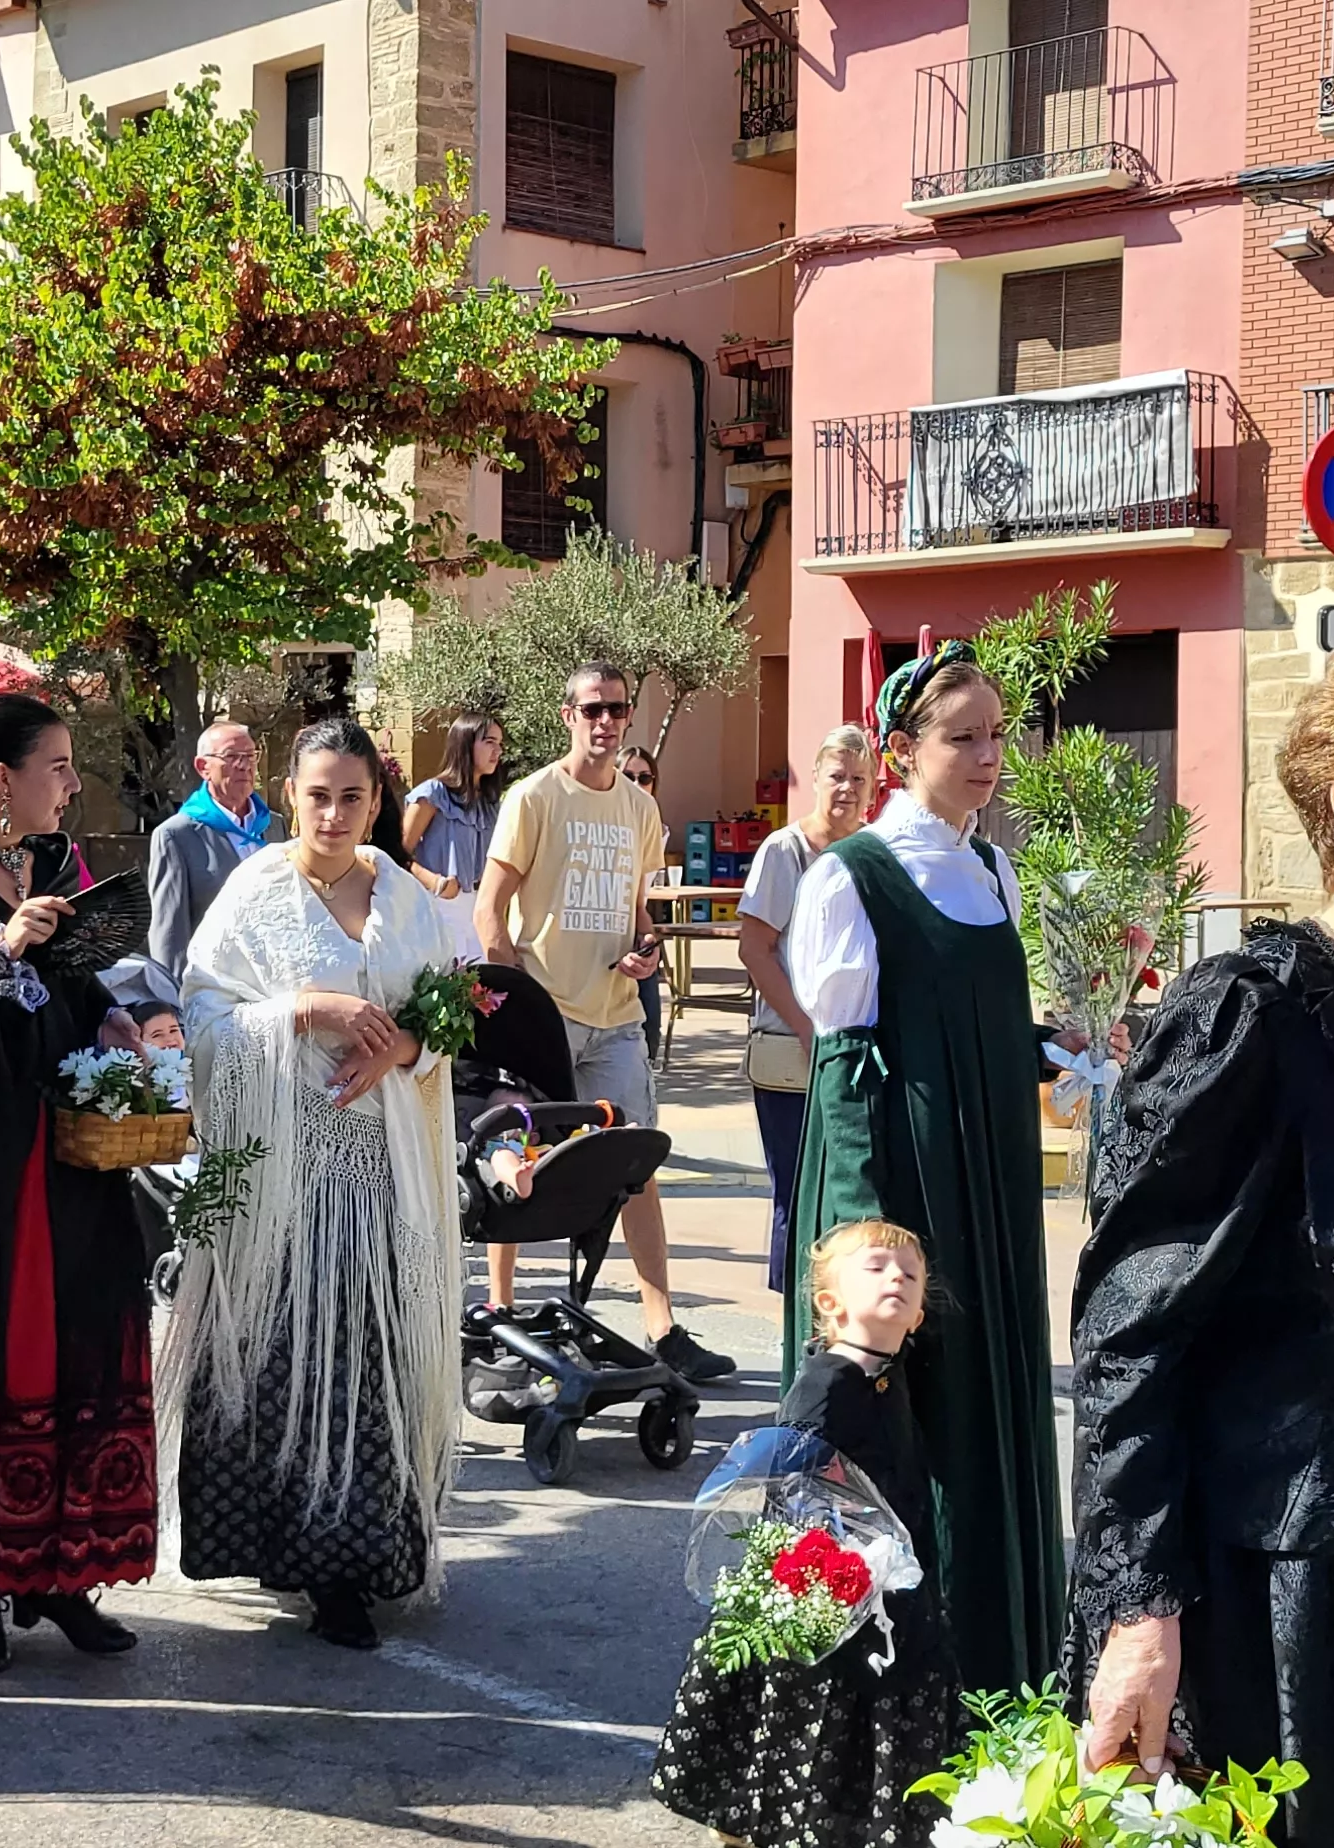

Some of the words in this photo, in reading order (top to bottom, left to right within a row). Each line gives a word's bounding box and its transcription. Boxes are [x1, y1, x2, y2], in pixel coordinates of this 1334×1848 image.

[566, 821, 573, 844] I
[590, 847, 616, 870] MY
[563, 911, 582, 929] TO
[584, 913, 600, 930] BE
[603, 914, 626, 932] HEE
